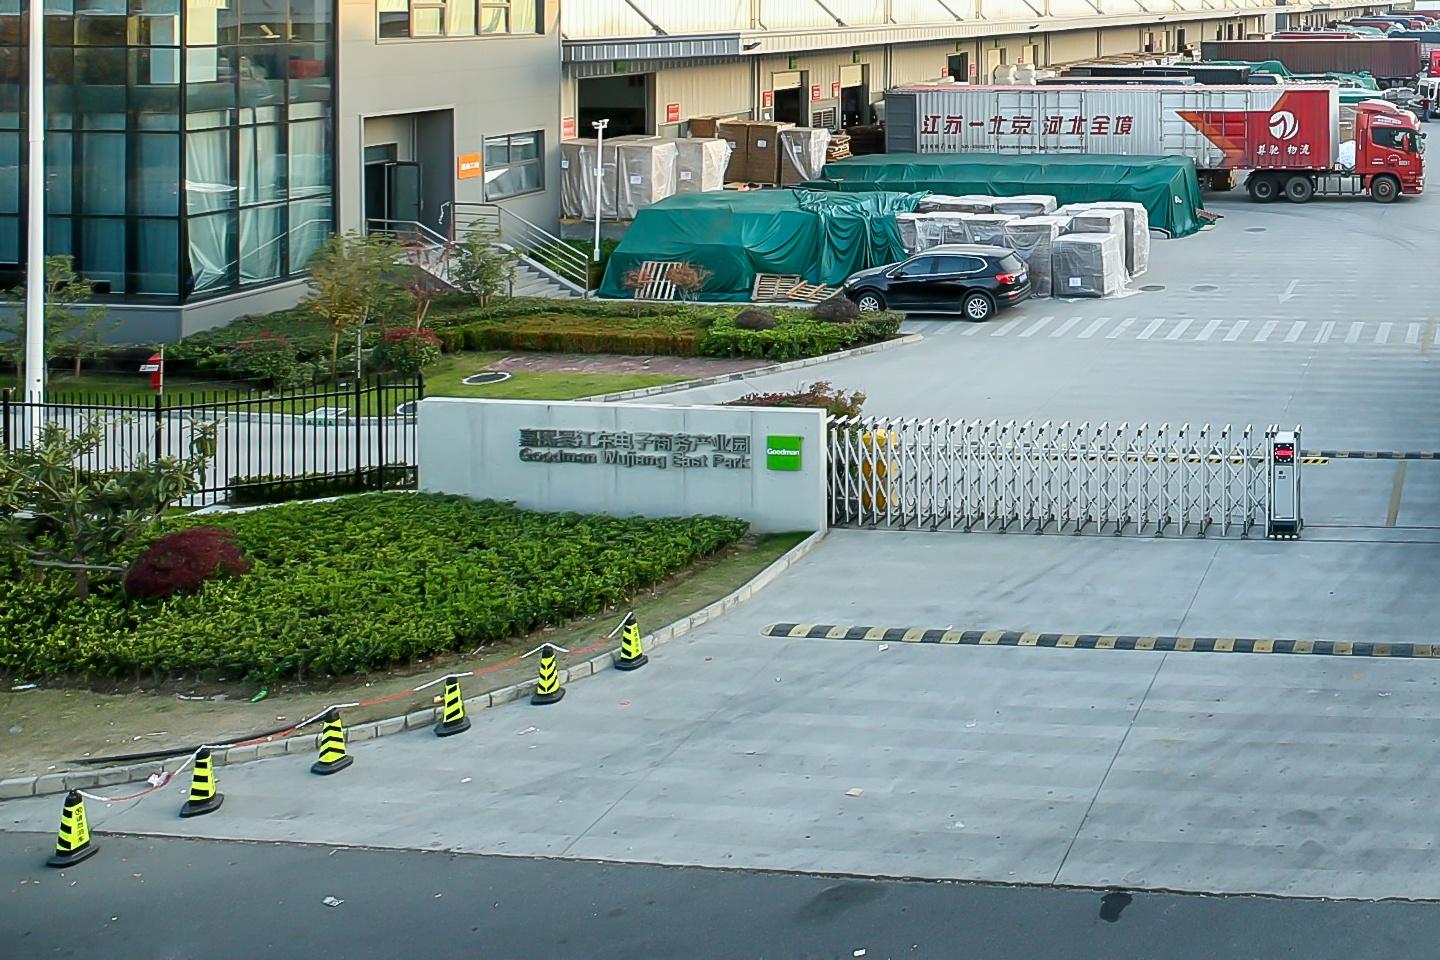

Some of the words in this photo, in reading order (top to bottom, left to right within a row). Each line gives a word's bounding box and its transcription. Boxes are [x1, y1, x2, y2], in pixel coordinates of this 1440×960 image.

[519, 447, 597, 464] Goodman
[602, 450, 667, 468] Wujiang
[672, 452, 708, 468] East
[713, 454, 751, 469] Park
